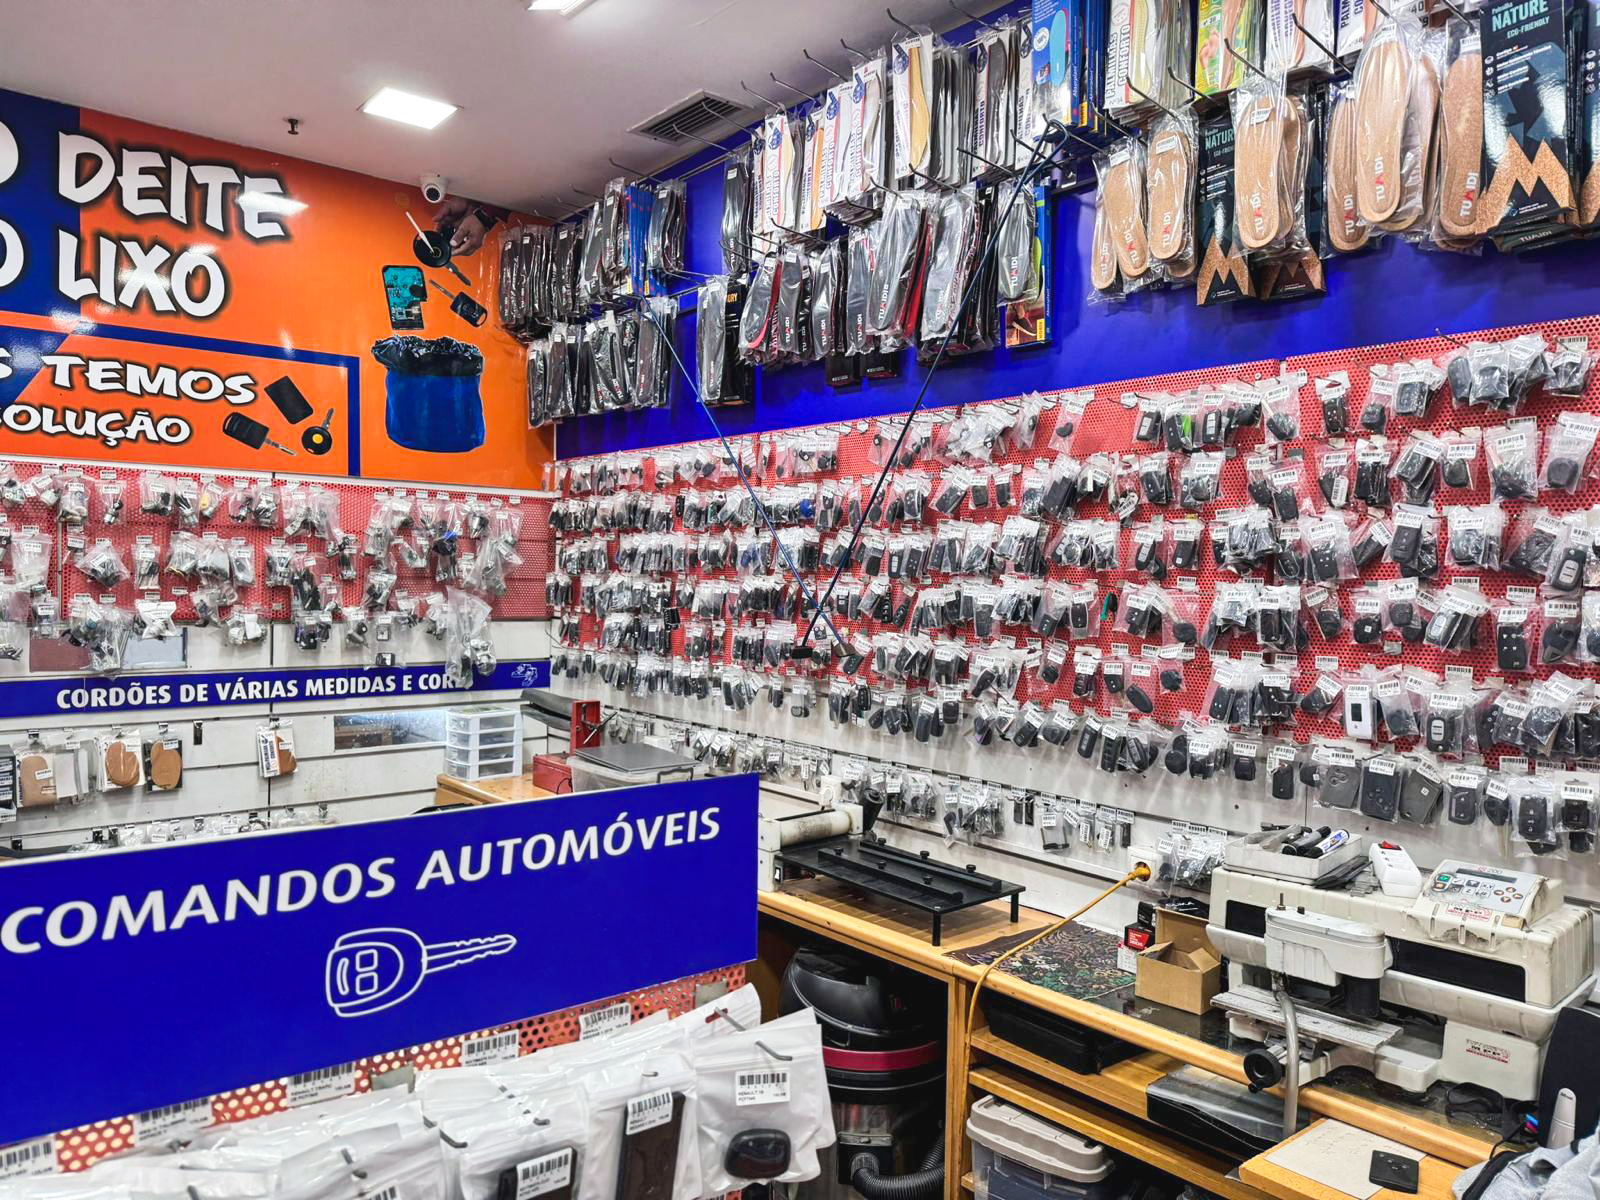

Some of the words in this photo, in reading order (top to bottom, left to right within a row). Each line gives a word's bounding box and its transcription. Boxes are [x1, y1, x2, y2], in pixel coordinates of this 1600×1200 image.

[1492, 0, 1549, 33] NATURE
[1105, 32, 1118, 100] PALMILHAS
[1117, 24, 1131, 87] CONFORTO
[1205, 127, 1235, 151] NATUR
[58, 131, 286, 239] DEITE
[58, 229, 226, 318] LIXO
[41, 355, 257, 405] TEMOS
[0, 404, 191, 446] OLUÇÃO
[56, 681, 172, 709] CORDÕES
[180, 683, 208, 703] DE
[215, 676, 299, 701] VÁRIAS
[305, 675, 396, 697] MEDIDAS
[402, 674, 413, 691] E
[418, 673, 462, 690] COR
[0, 856, 396, 954] COMANDOS
[415, 807, 720, 890] AUTOMÓVEIS
